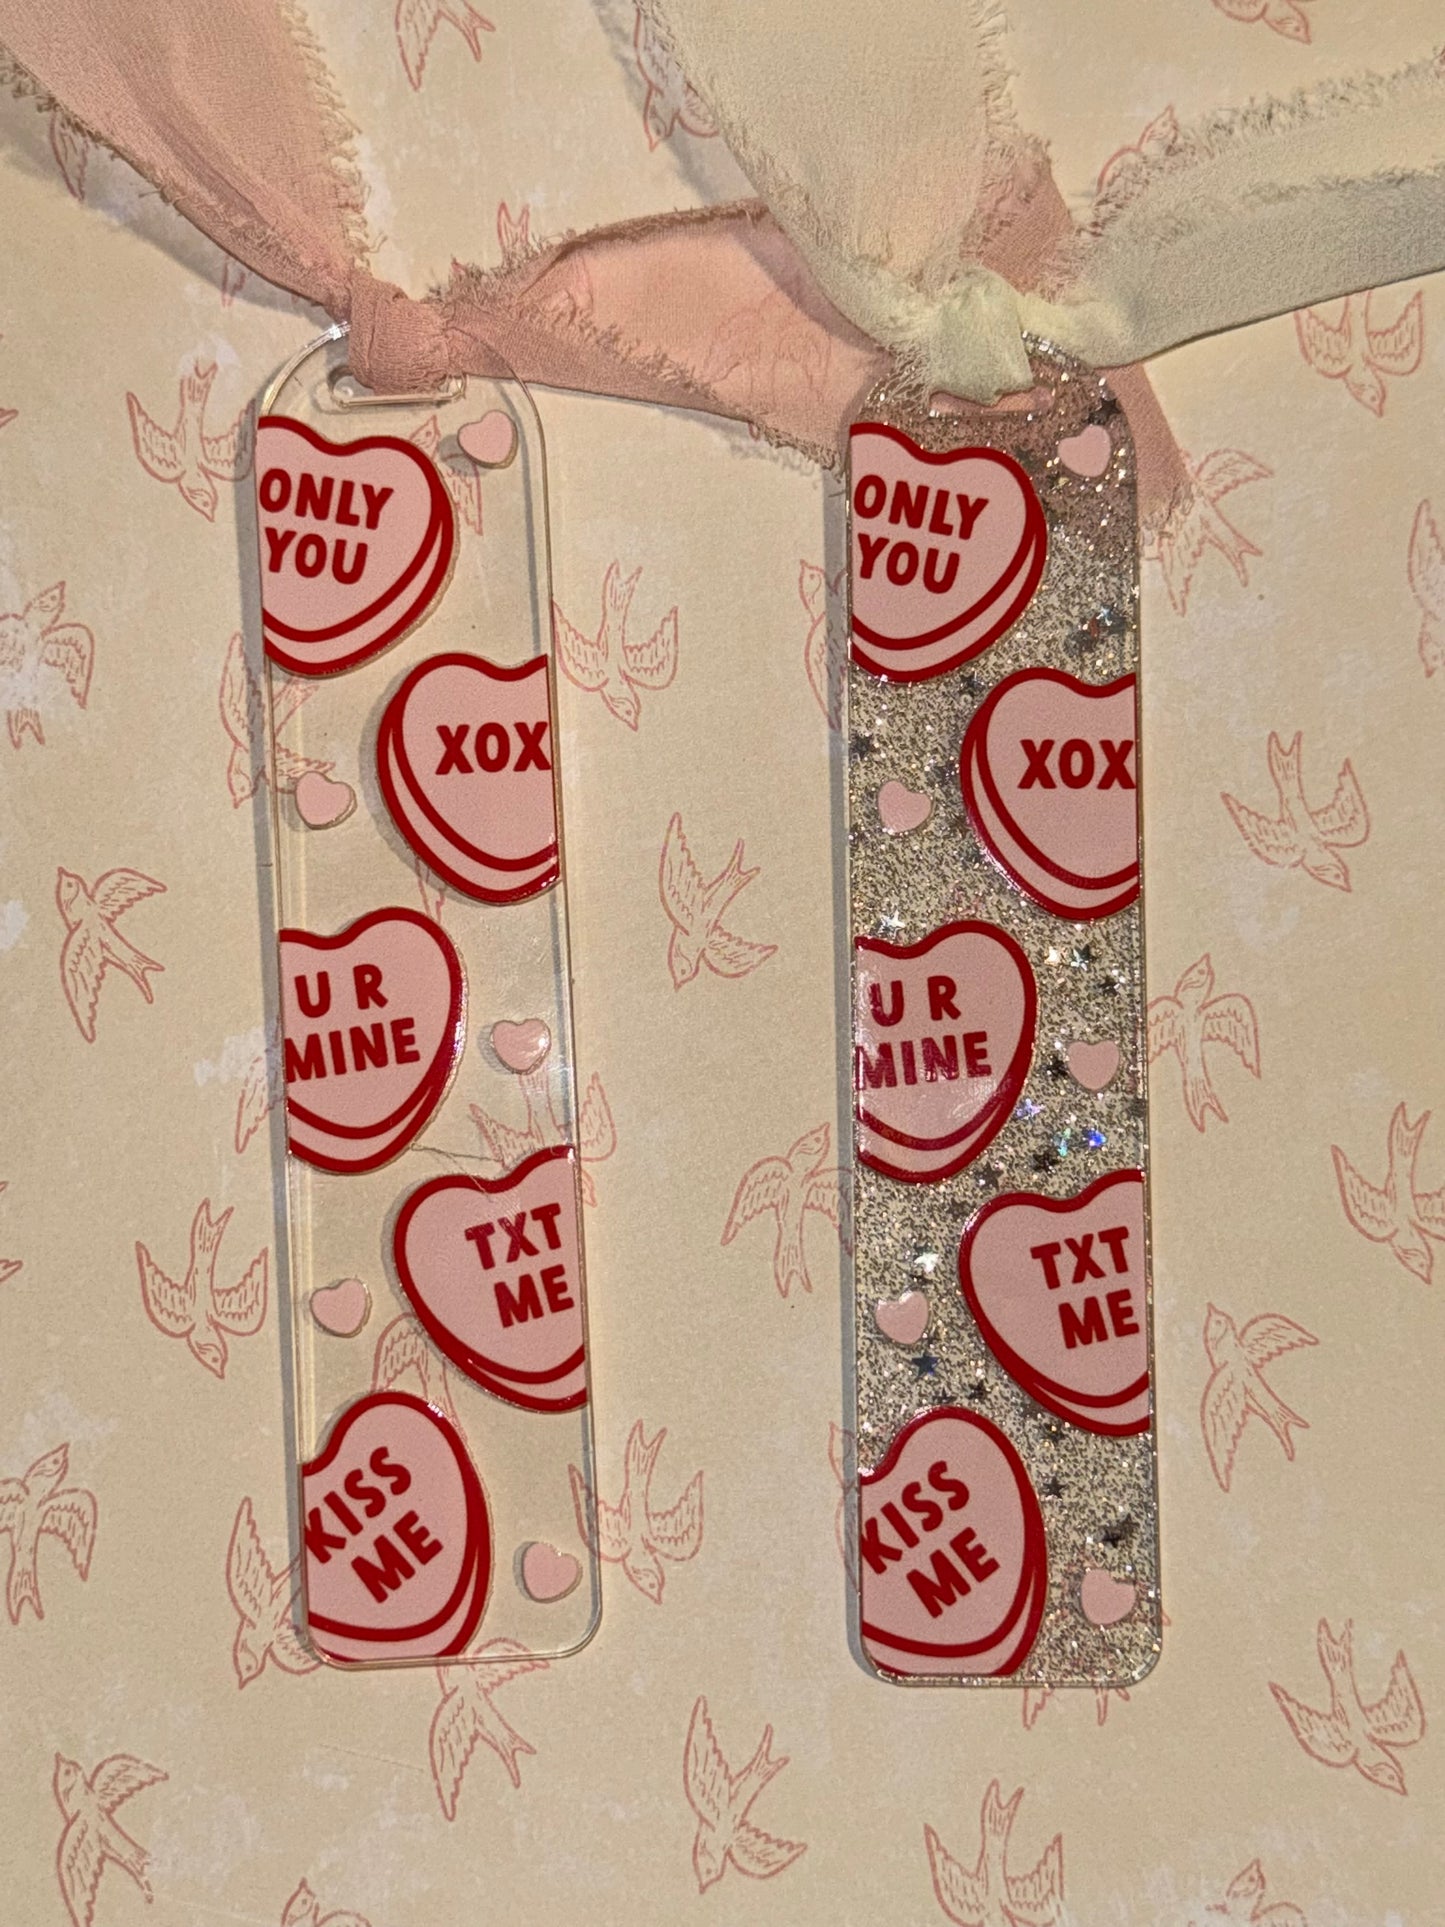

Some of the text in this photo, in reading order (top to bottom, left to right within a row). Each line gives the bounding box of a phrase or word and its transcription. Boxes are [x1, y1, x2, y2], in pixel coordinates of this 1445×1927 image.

[259, 467, 394, 530] ONLY
[853, 474, 989, 540] ONLY
[264, 527, 368, 585] YOU
[857, 533, 960, 594] YOU
[435, 721, 551, 775] XOX
[1017, 738, 1136, 790] XOX
[294, 964, 388, 1018] U R
[869, 975, 961, 1027] U R
[284, 1017, 420, 1083] MINE
[856, 1031, 992, 1091] MINE
[464, 1202, 561, 1270] TXT
[1030, 1226, 1129, 1290] TXT
[494, 1264, 574, 1328] ME
[1058, 1288, 1140, 1349] ME
[304, 1446, 411, 1564] KISS
[861, 1460, 970, 1575] KISS
[351, 1510, 443, 1603] ME
[906, 1527, 1000, 1618] ME
